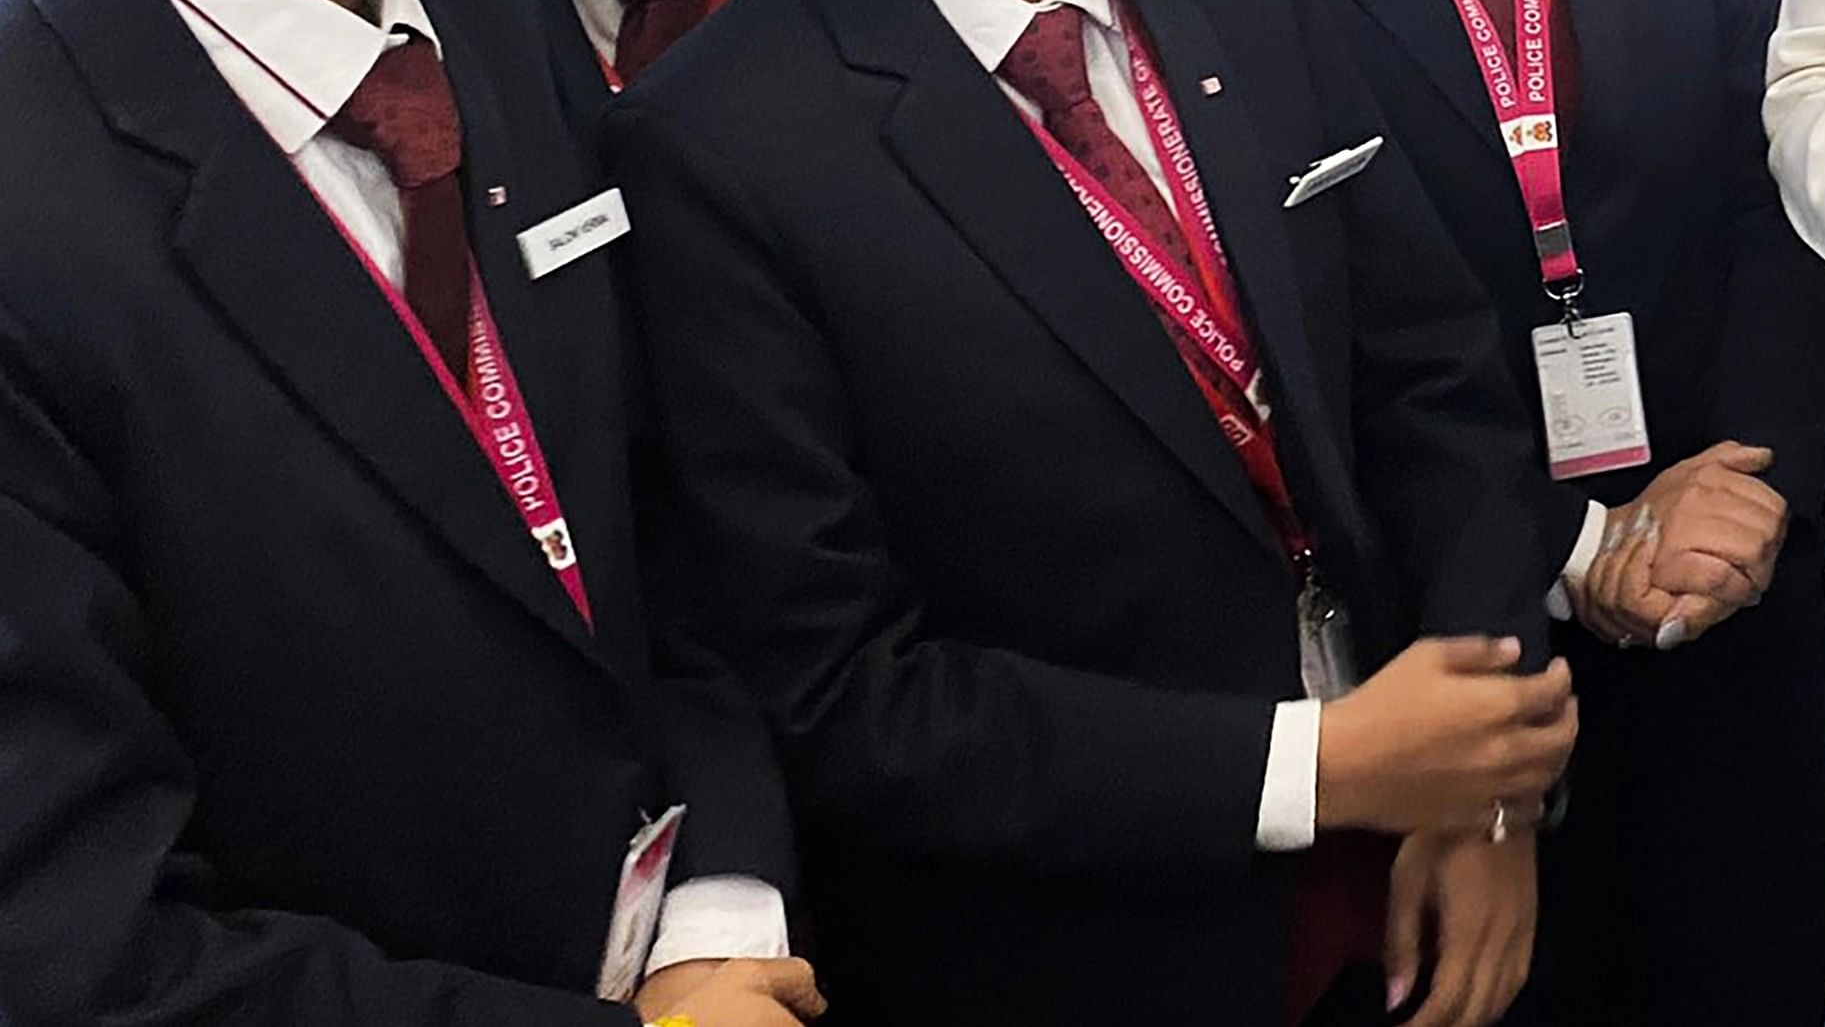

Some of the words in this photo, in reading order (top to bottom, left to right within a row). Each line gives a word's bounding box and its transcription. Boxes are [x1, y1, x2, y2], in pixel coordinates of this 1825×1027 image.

[1481, 44, 1516, 109] POLICE
[1525, 38, 1545, 103] POLICE
[1189, 309, 1245, 372] POLICE
[493, 421, 546, 512] POLICE
